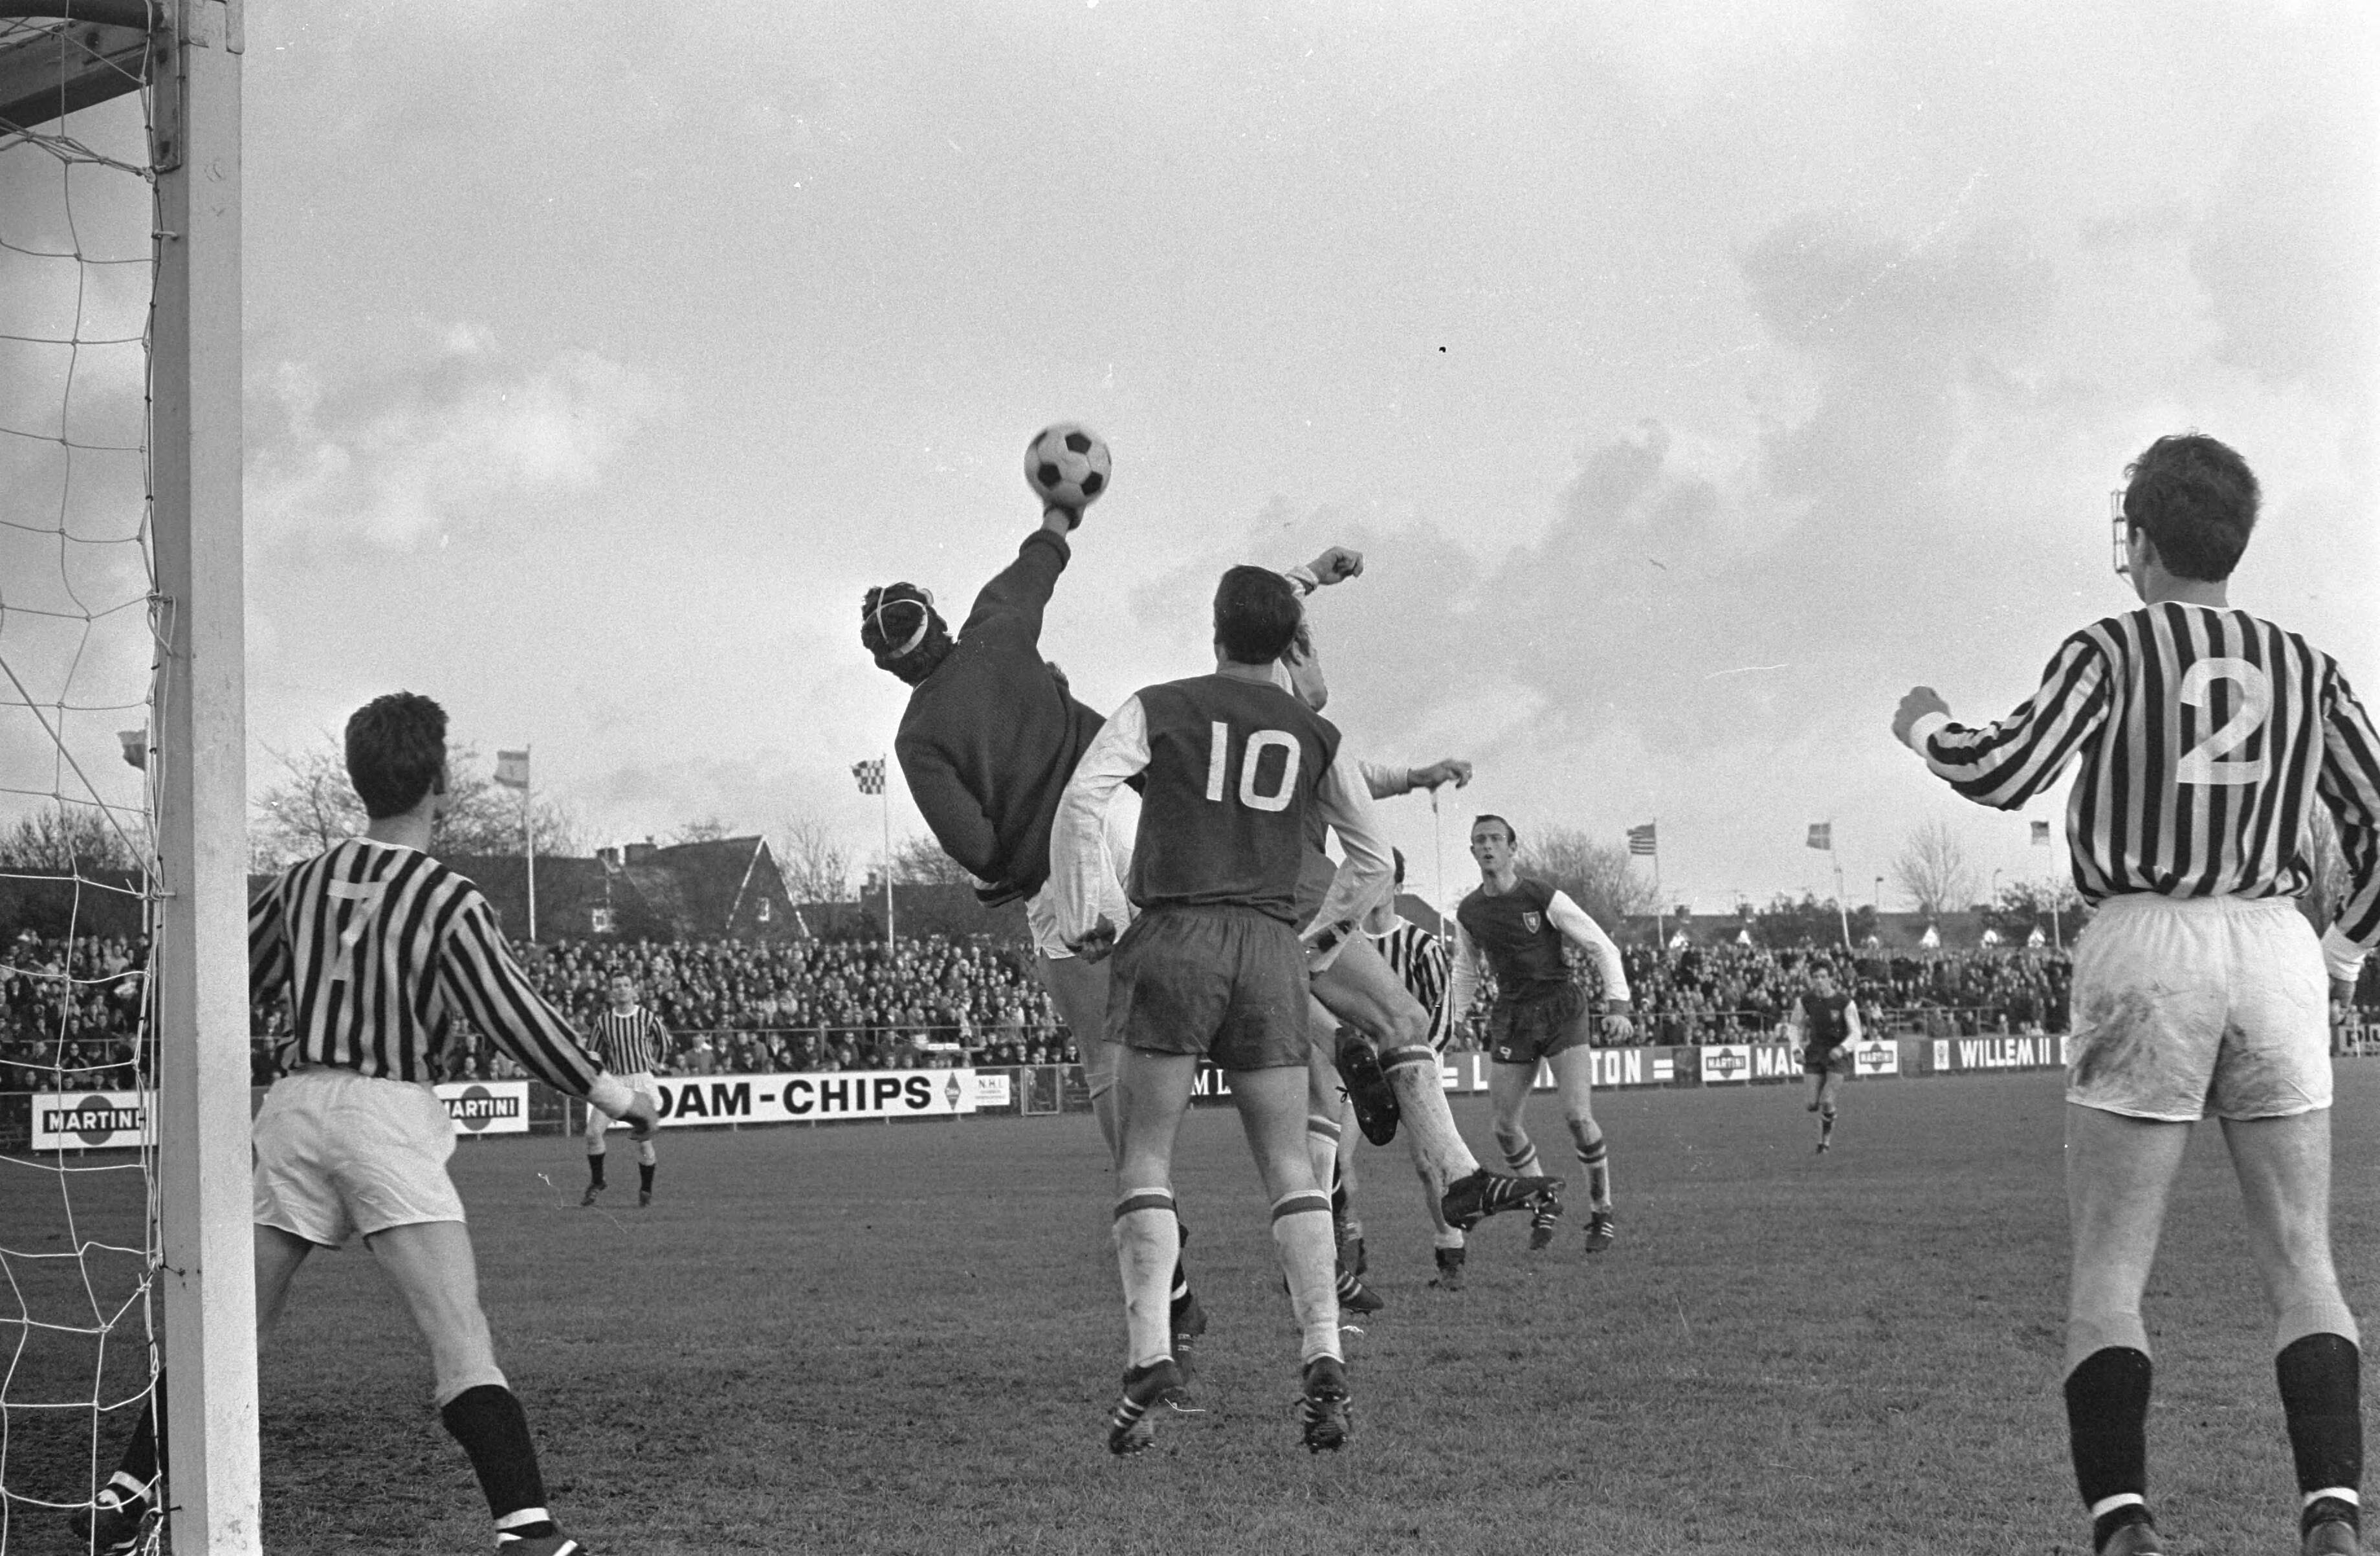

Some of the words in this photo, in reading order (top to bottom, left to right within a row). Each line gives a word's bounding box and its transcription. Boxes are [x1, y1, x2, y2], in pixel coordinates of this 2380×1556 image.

[2176, 658, 2273, 785] 2
[1206, 721, 1301, 812] 10
[327, 879, 388, 981] 7
[1708, 1057, 1745, 1068] MARTINI
[1959, 1038, 2034, 1068] WILLEM
[2039, 1038, 2051, 1064] II
[49, 1111, 141, 1131] MARTINI
